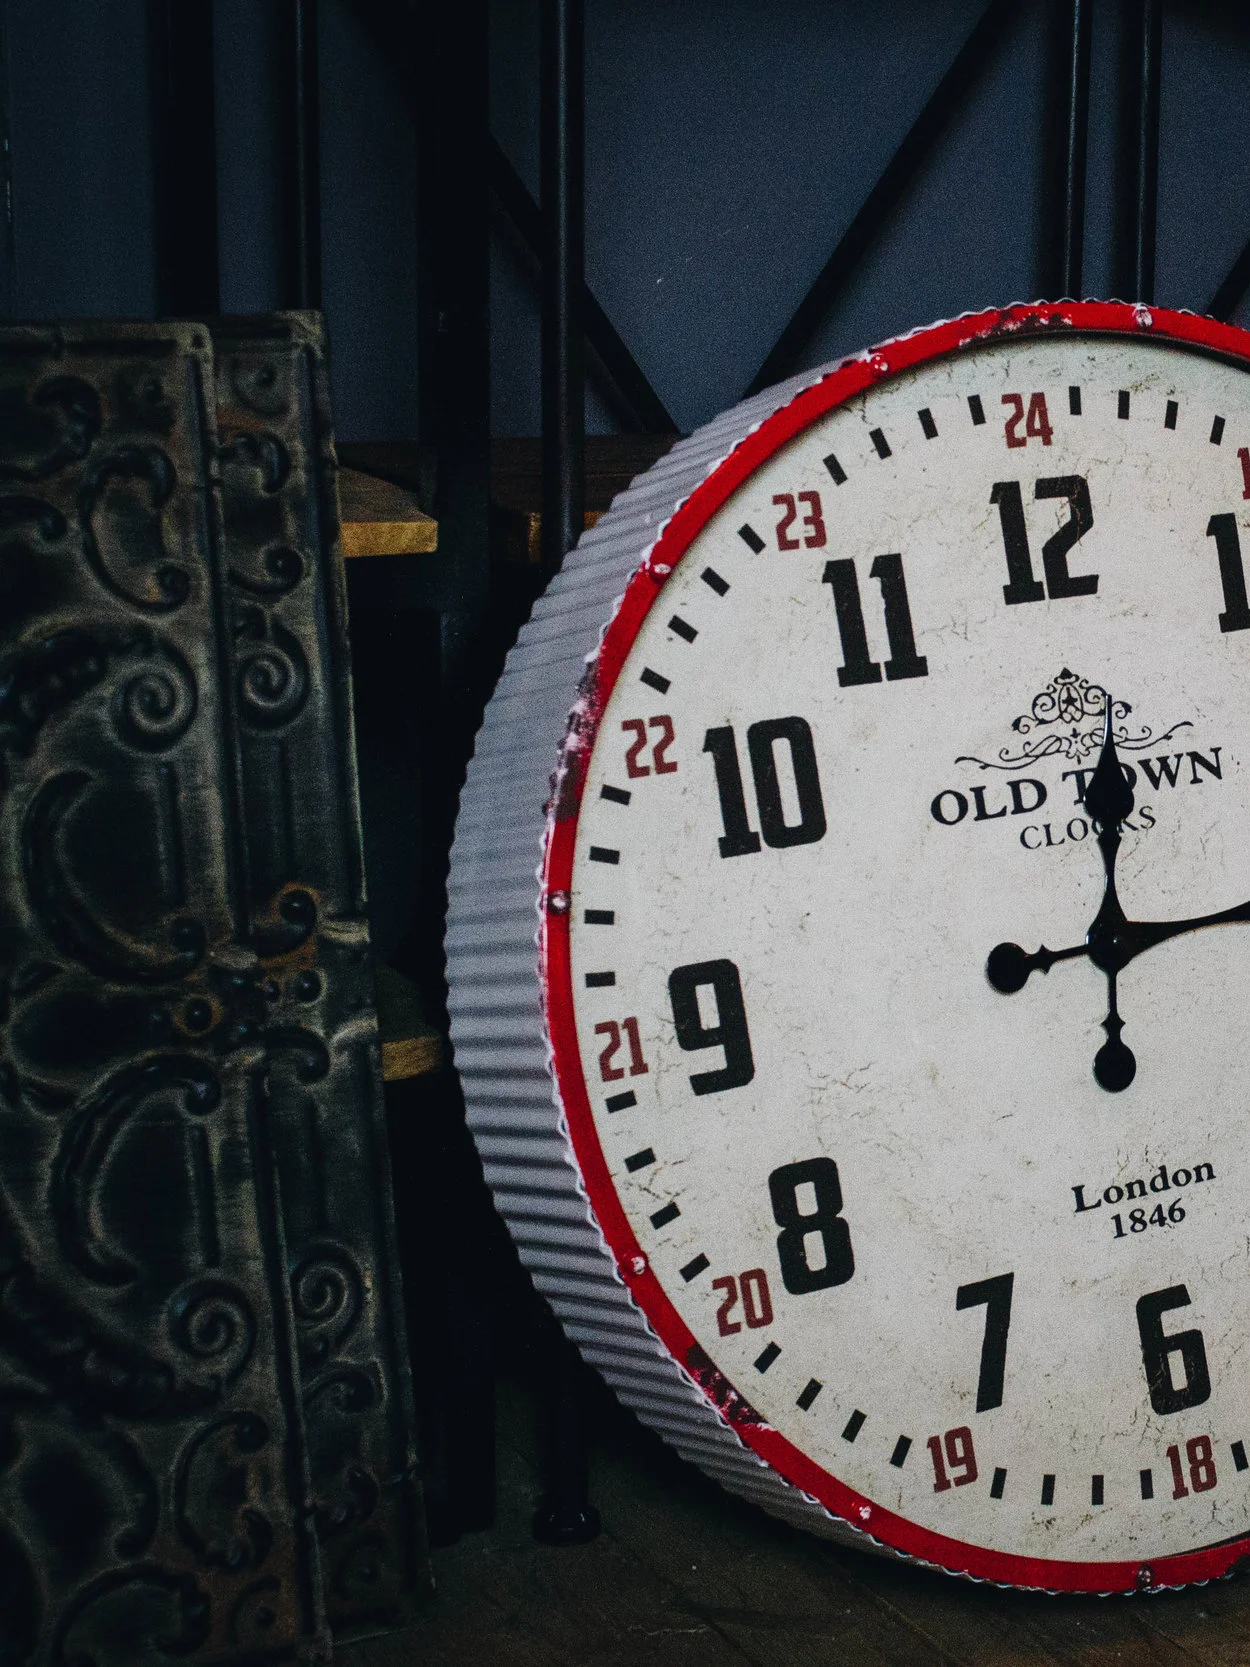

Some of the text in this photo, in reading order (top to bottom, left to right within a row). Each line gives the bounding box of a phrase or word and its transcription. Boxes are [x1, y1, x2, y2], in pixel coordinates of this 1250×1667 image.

[1001, 392, 1053, 448] 24
[772, 491, 827, 551] 23
[989, 475, 1099, 605] 12
[822, 553, 928, 687] 11
[622, 715, 677, 778] 22
[702, 716, 827, 859] 10
[931, 778, 1048, 825] OLD
[595, 1017, 648, 1082] 21
[668, 959, 755, 1096] 9
[1071, 1162, 1217, 1213] London
[1111, 1198, 1186, 1239] 1846
[768, 1157, 855, 1295] 8
[712, 1268, 773, 1337] 20
[956, 1272, 1014, 1413] 7
[1136, 1284, 1211, 1416] 6
[927, 1426, 978, 1493] 19
[1166, 1435, 1217, 1500] 18
